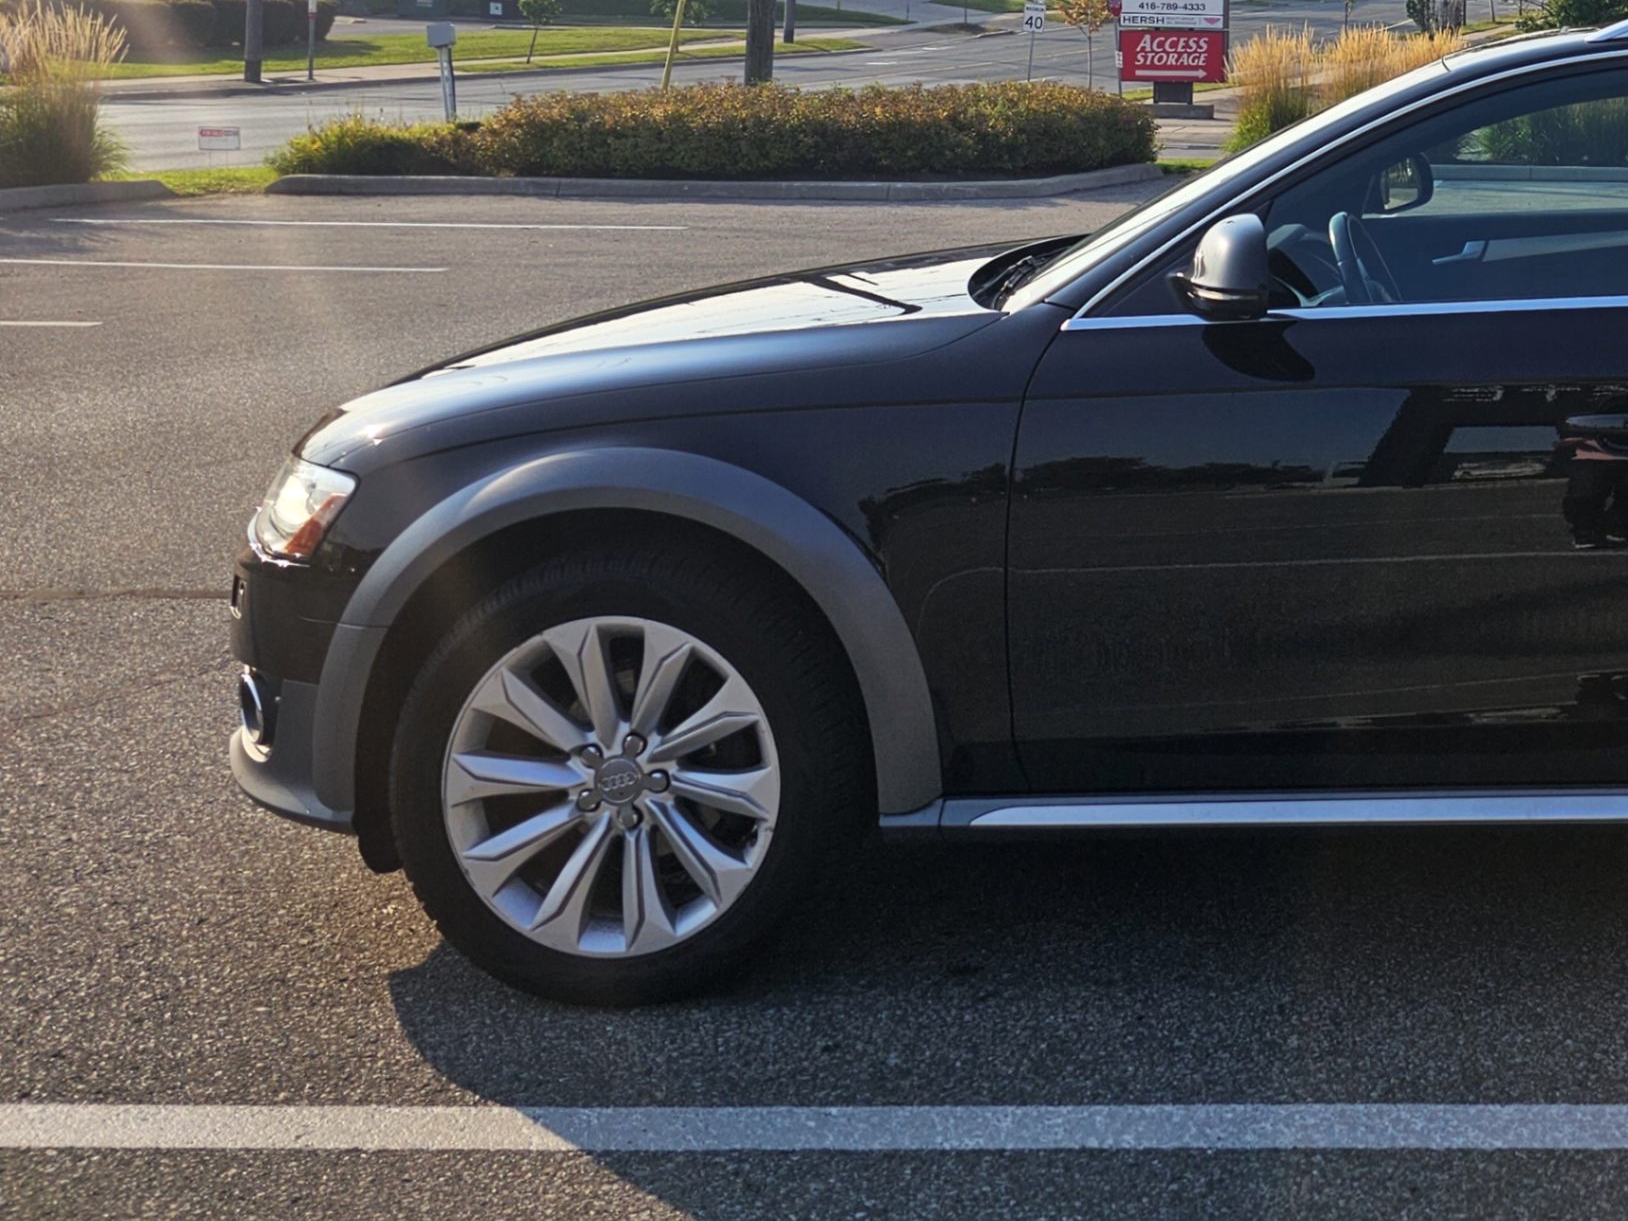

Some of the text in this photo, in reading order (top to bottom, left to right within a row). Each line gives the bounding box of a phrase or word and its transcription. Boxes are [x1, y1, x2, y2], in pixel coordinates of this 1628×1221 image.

[1138, 2, 1206, 11] 416-789-4333
[1024, 16, 1043, 29] 40
[1122, 15, 1165, 25] HERSH
[1134, 52, 1208, 66] STORAGE
